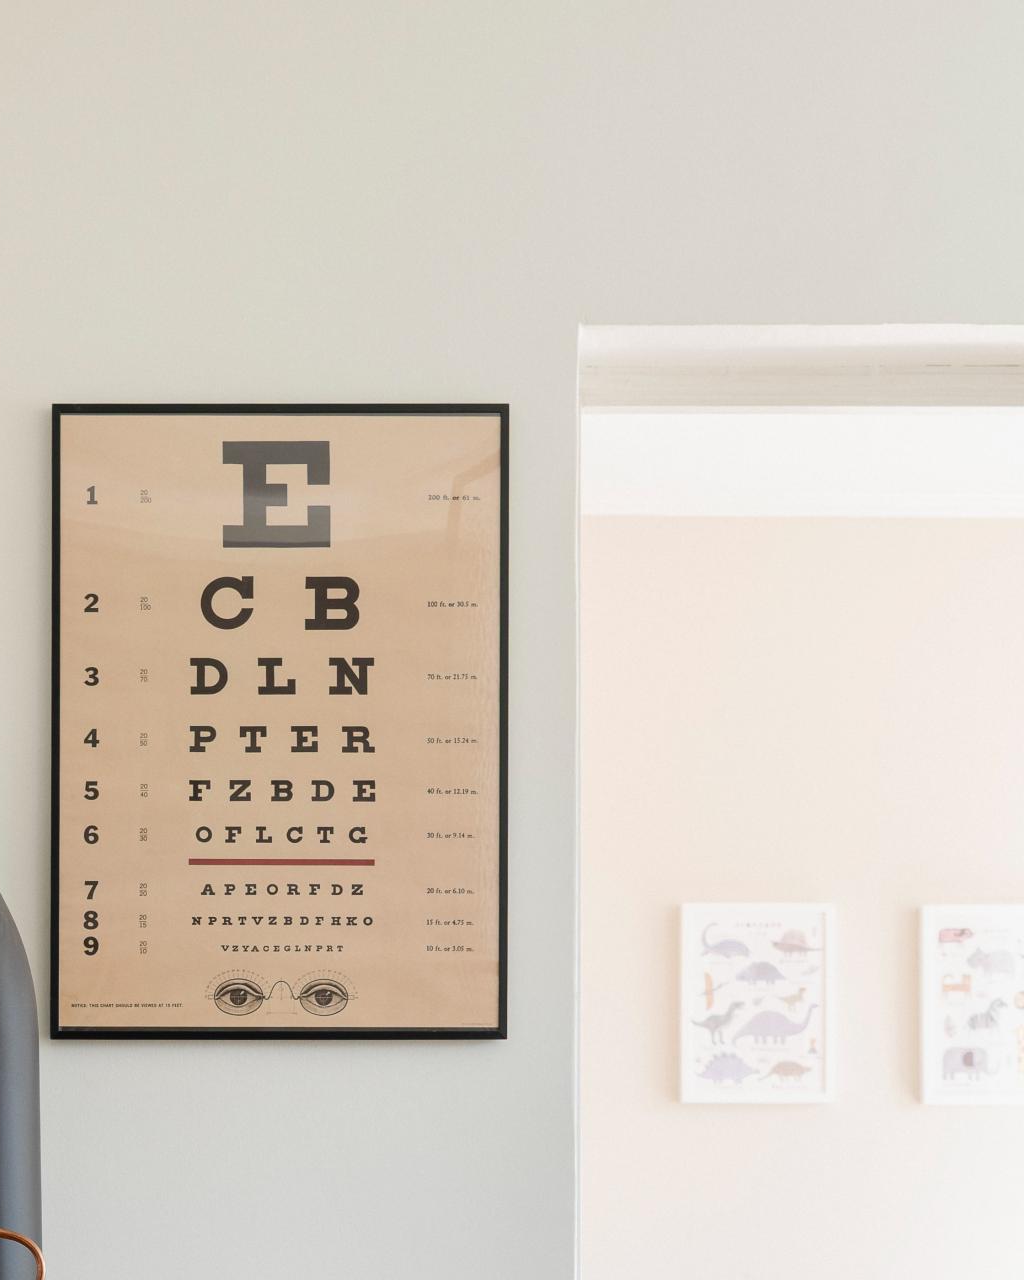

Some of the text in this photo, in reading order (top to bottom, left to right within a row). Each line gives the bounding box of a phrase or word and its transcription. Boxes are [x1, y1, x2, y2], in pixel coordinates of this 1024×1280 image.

[86, 486, 99, 505] 1
[222, 441, 331, 548] E
[427, 494, 441, 502] 200
[84, 593, 100, 612] 2
[84, 667, 100, 686] 3
[427, 673, 436, 681] 70
[83, 729, 100, 748] 4
[83, 781, 100, 800] 5
[83, 825, 100, 844] 6
[84, 881, 99, 900] 7
[426, 887, 435, 895] 20
[83, 911, 99, 930] 8
[83, 936, 99, 956] 9
